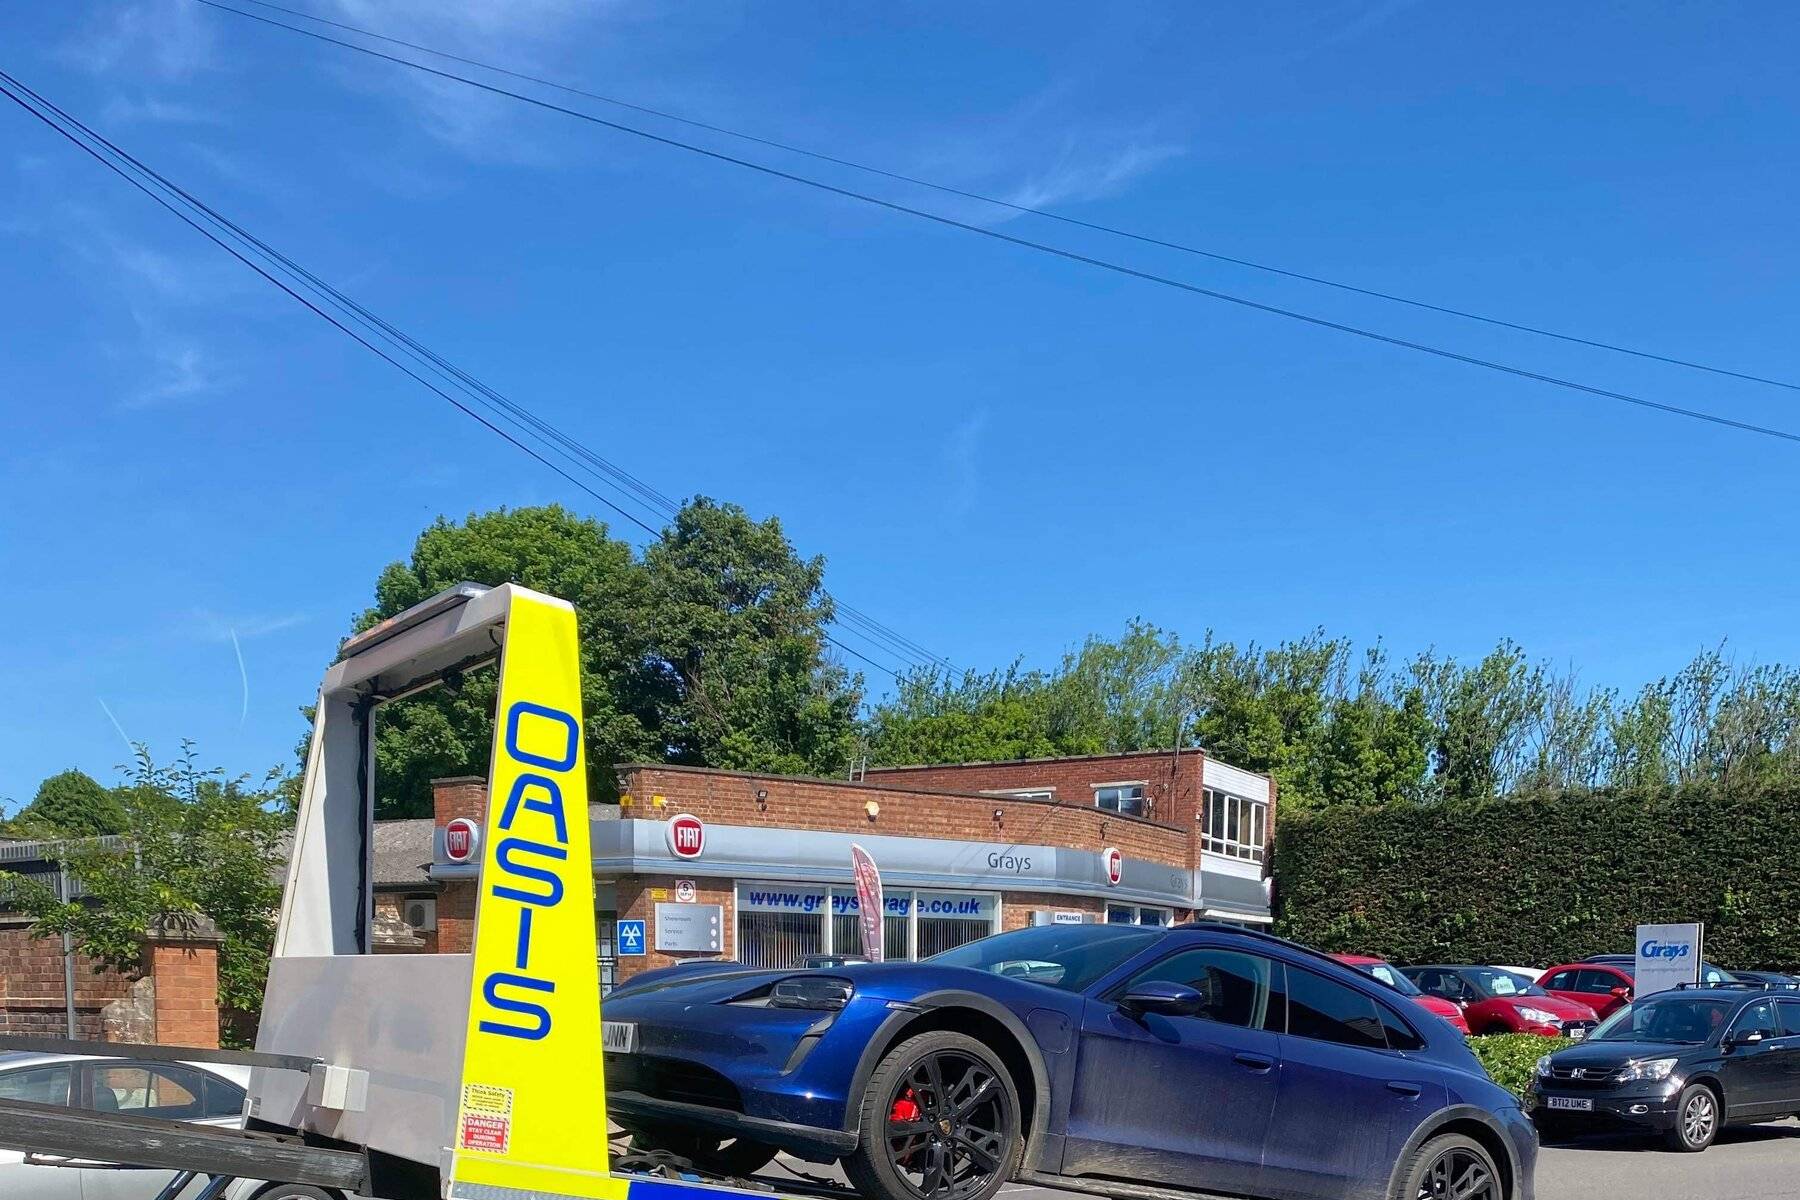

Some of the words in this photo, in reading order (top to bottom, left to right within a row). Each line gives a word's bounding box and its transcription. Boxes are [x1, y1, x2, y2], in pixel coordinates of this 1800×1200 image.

[449, 831, 467, 851] FIAT
[677, 826, 700, 848] FIAT
[480, 701, 580, 1041] OASIS
[987, 852, 1032, 873] Grays
[683, 883, 689, 892] 5
[749, 891, 981, 915] www.graysrage.co.uk
[1056, 914, 1081, 922] ENTRANCE
[1641, 940, 1689, 961] Grays
[1552, 1098, 1570, 1108] BT12
[468, 1118, 503, 1129] DANGER
[468, 1140, 501, 1148] OPERATION
